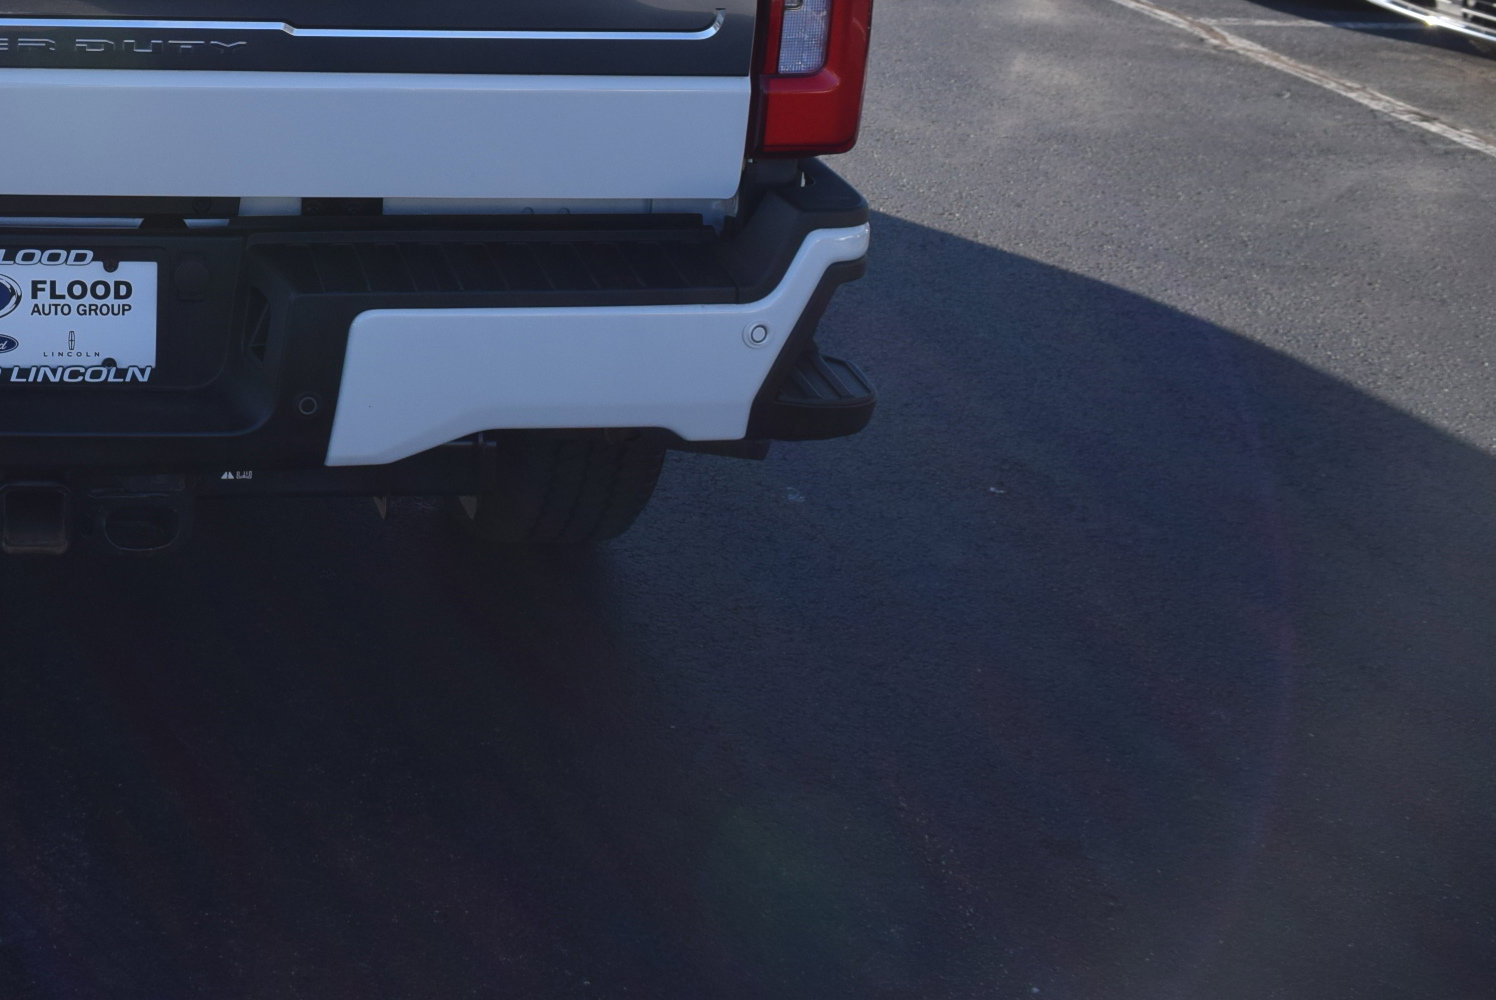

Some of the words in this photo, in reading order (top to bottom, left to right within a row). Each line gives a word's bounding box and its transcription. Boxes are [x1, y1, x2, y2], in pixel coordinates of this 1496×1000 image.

[75, 38, 248, 53] DUTY
[30, 279, 133, 300] FLOOD
[30, 303, 71, 316] AUTO
[76, 303, 132, 317] GROUP
[9, 366, 153, 383] LINCOLN
